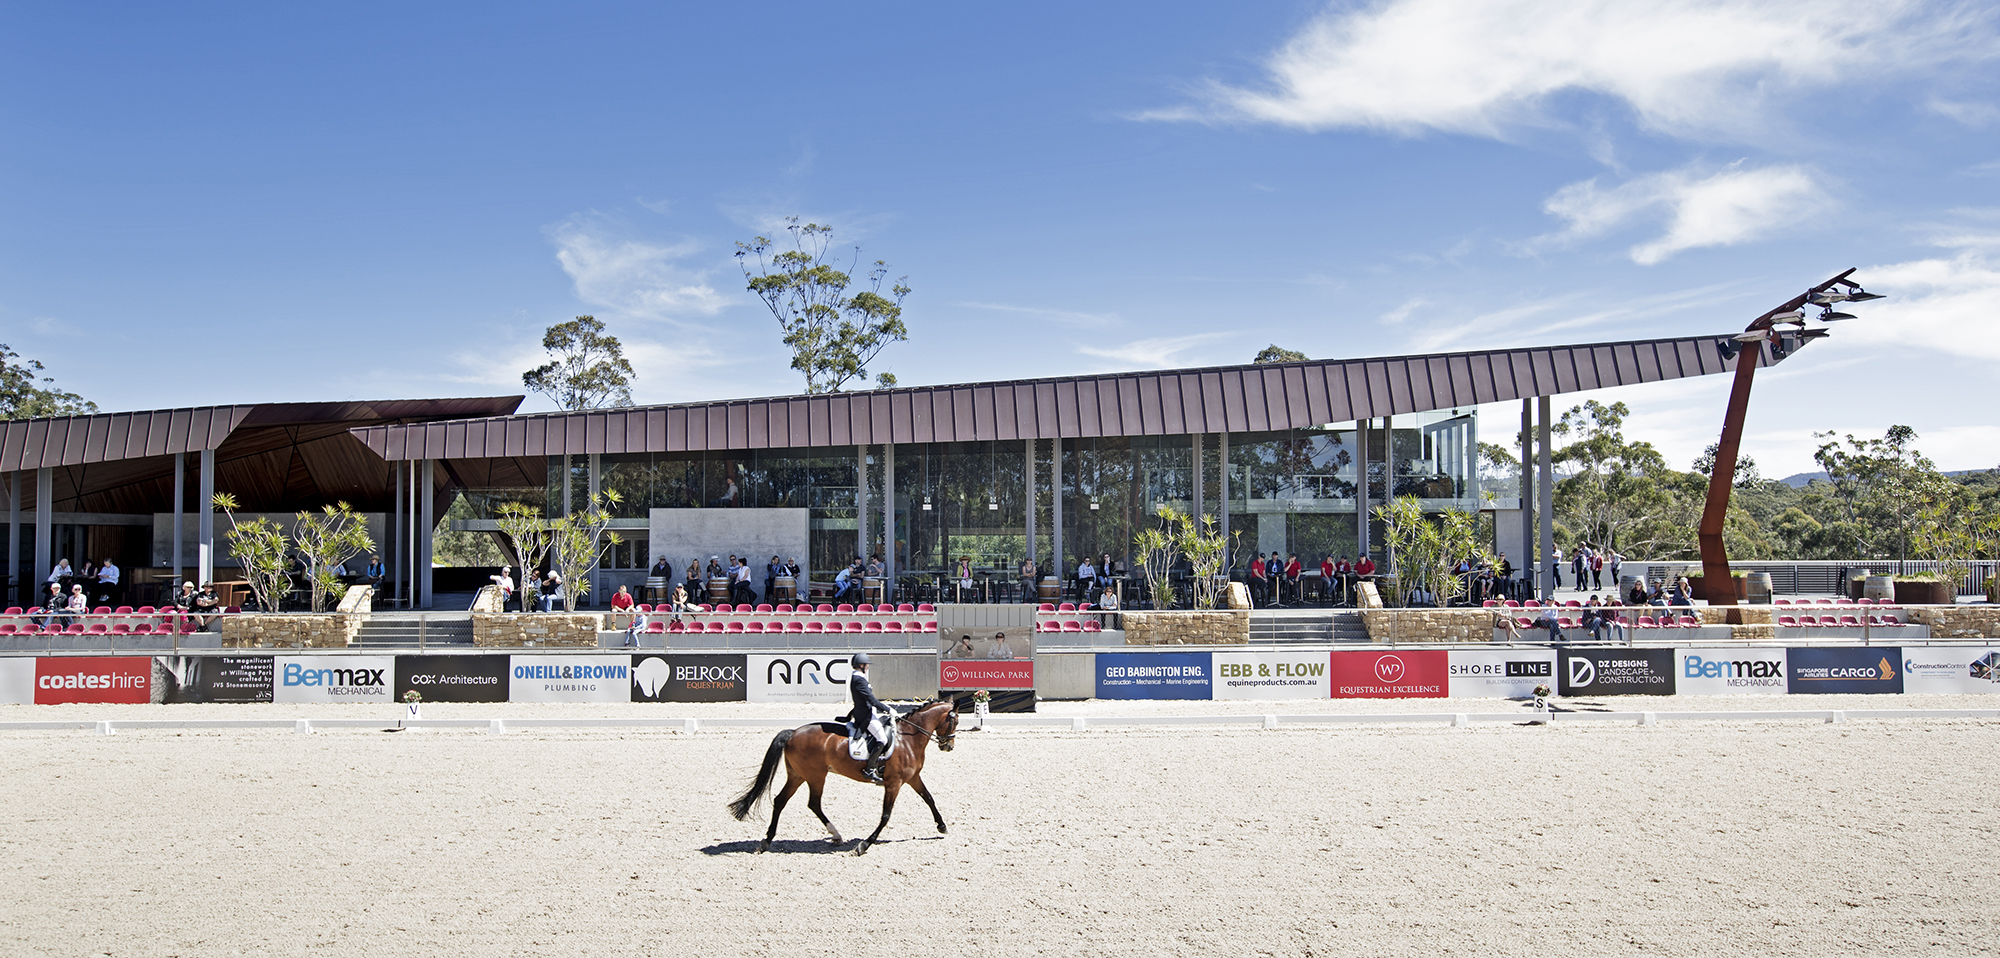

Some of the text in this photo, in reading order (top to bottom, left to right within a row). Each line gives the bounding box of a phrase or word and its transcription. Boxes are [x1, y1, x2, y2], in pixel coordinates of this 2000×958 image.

[236, 657, 273, 665] magnificent
[1598, 660, 1648, 668] DZ DESIGNS
[768, 659, 848, 684] ARC
[1106, 666, 1205, 677] GEO BABINGTON ENG.
[1220, 663, 1325, 677] EBB & FLOW
[1450, 664, 1548, 674] SHORE LINE
[1684, 655, 1783, 678] Benmax
[283, 663, 385, 687] Benmax
[676, 665, 745, 683] BELROCK
[1830, 668, 1876, 678] CARGO
[439, 674, 498, 685] Architecture
[1227, 679, 1317, 687] equineproducts.com.au
[1599, 676, 1664, 684] CONSTRUCTION
[1727, 679, 1783, 687] MECHANICAL
[545, 684, 597, 692] PLUMBING
[686, 681, 734, 690] EQUESTRIAN
[1340, 685, 1440, 695] EQUESTRIAN EXCELLENCE
[327, 687, 386, 695] MECHANICAL
[1536, 698, 1544, 708] S
[410, 704, 418, 715] V
